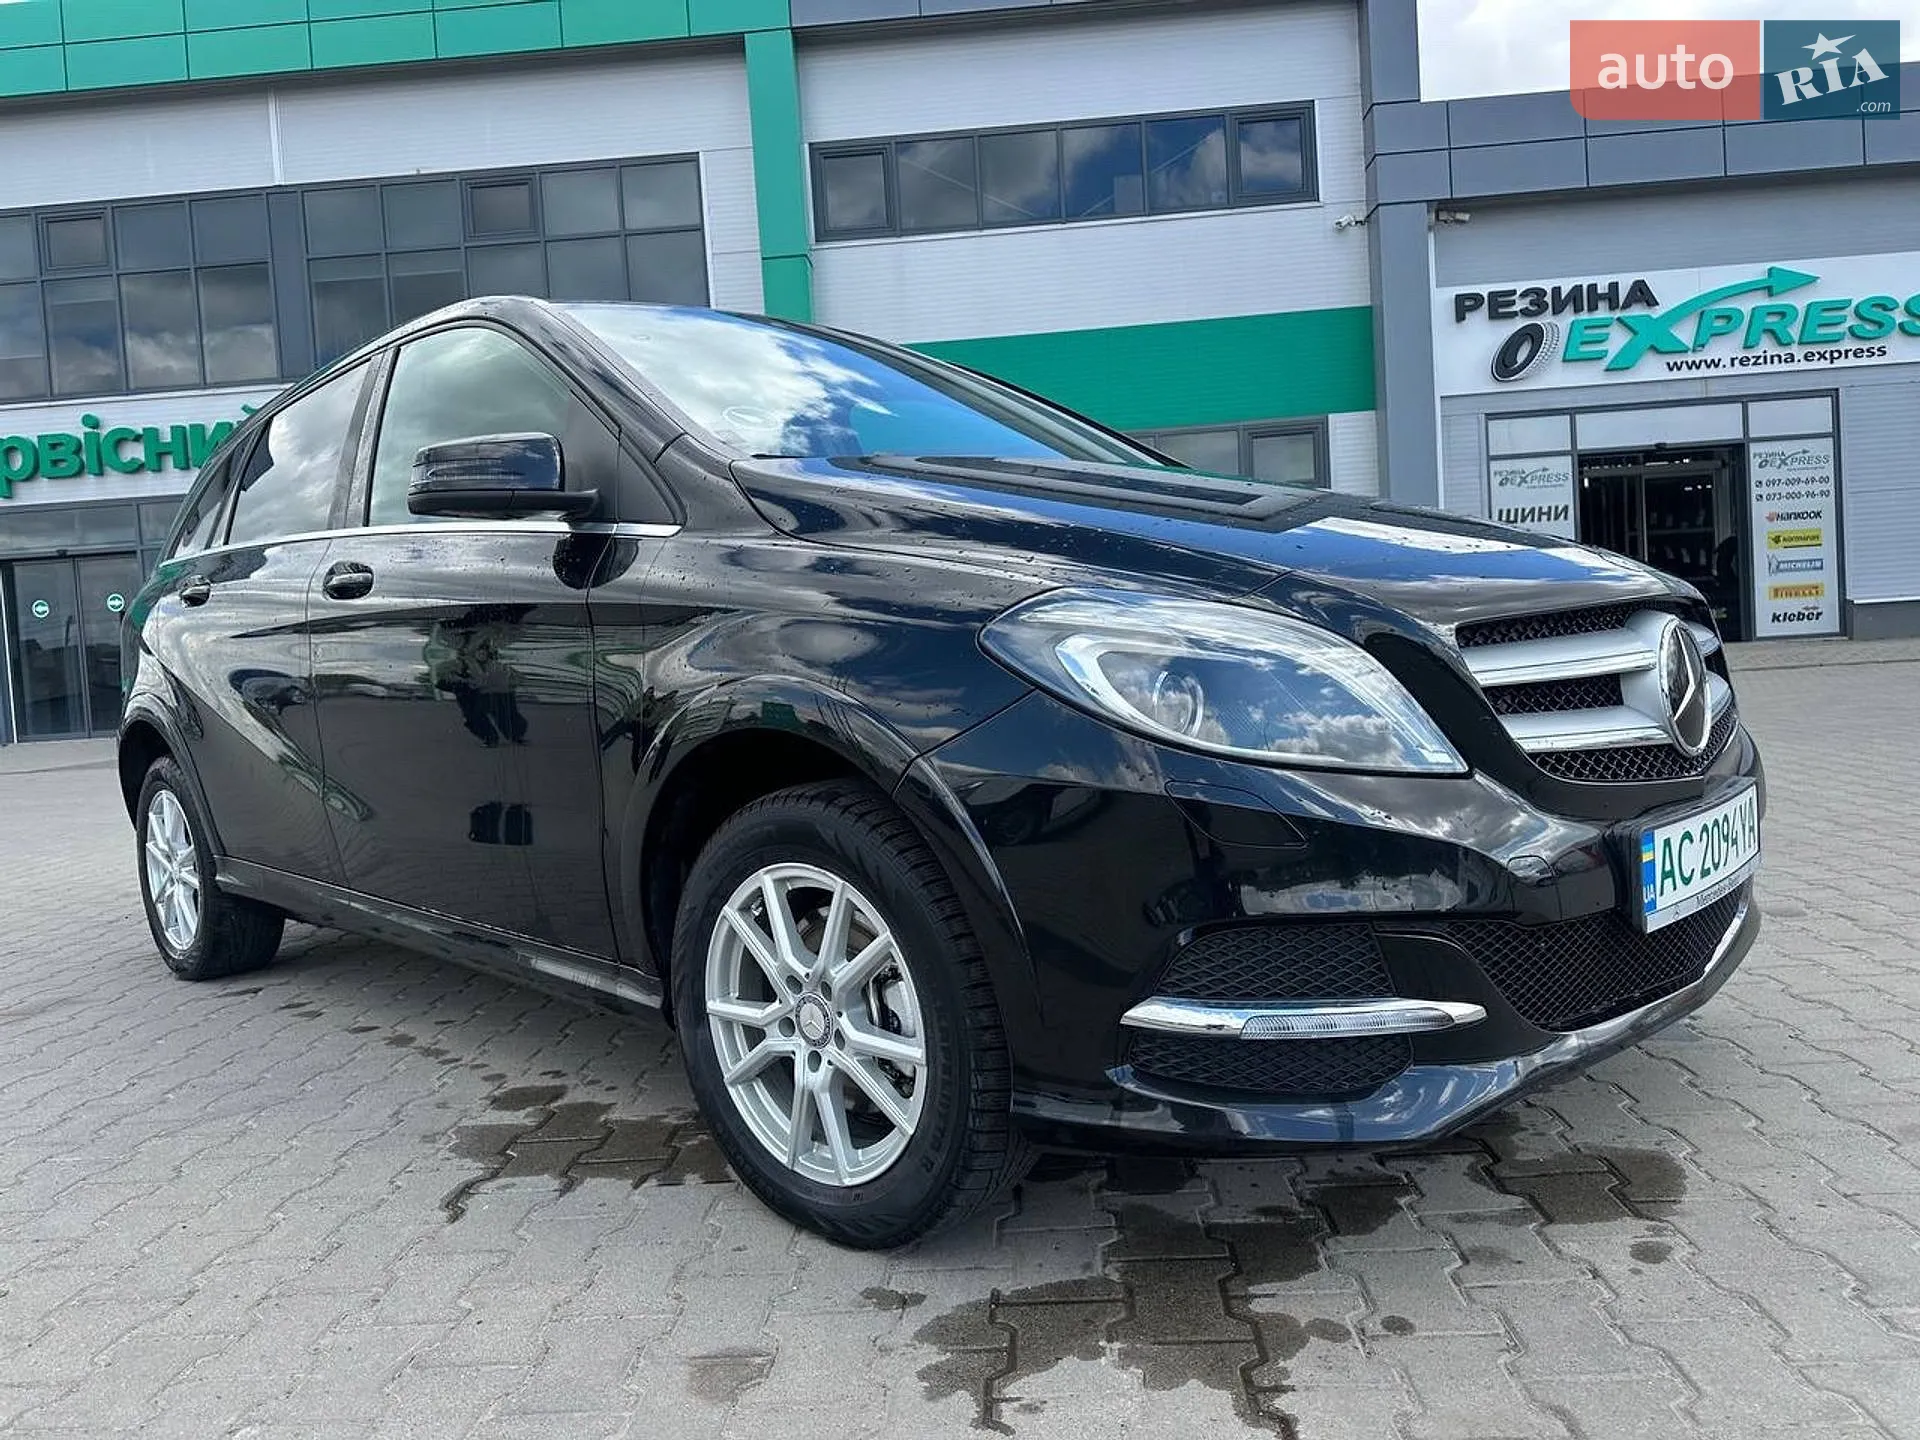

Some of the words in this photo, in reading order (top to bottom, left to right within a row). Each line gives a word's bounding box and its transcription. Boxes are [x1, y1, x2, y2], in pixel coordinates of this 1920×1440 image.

[1454, 279, 1660, 323] РЕЗИНА
[1666, 345, 1887, 372] www.rezina.express
[0, 404, 259, 499] рвісни
[1498, 504, 1569, 523] ШИНИ
[1660, 830, 1695, 897] AC
[1699, 810, 1739, 879] 2094
